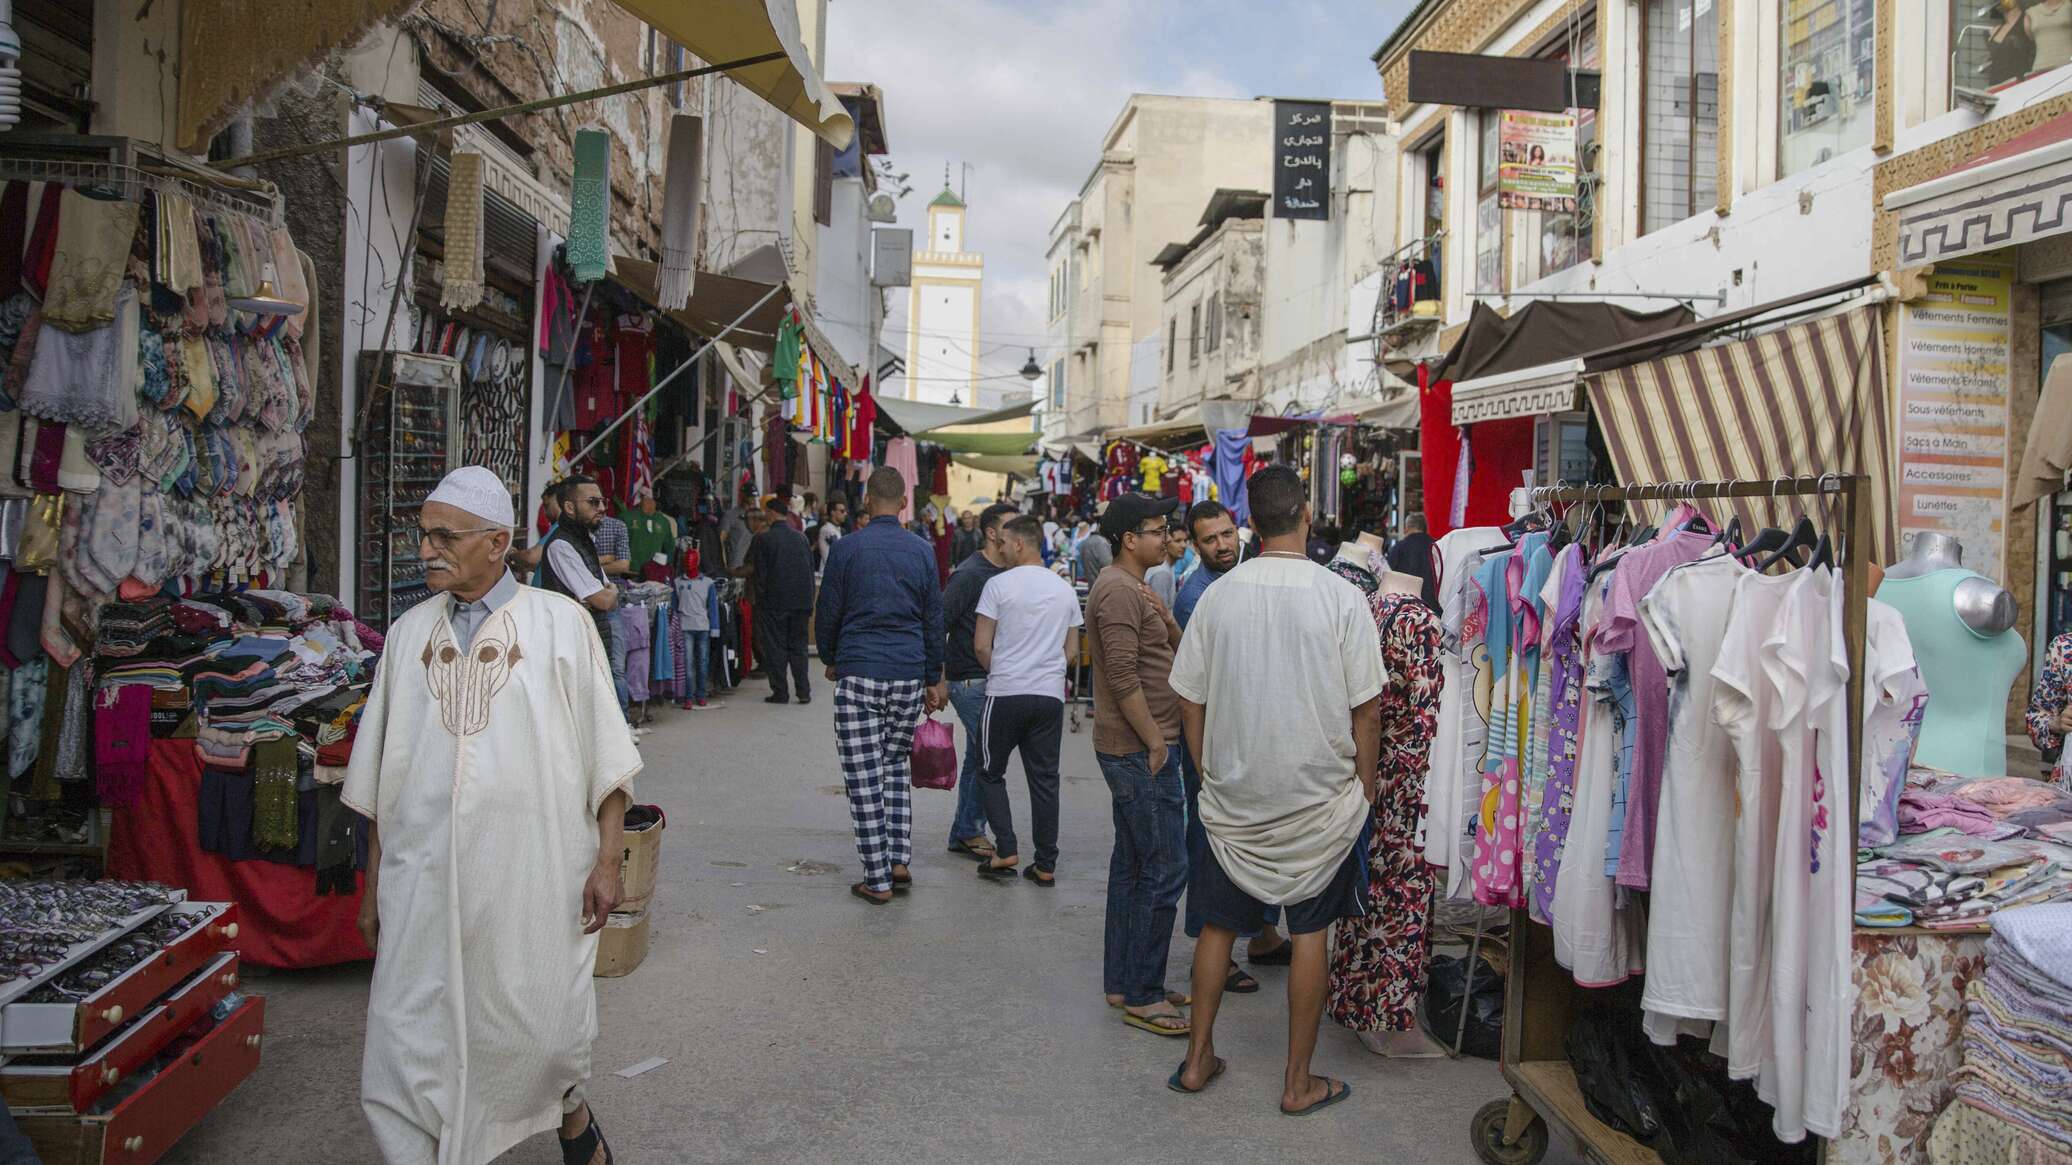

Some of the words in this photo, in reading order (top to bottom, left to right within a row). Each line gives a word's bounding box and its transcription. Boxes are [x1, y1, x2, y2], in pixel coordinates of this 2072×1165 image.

[1956, 282, 1978, 291] Porter
[1912, 308, 1964, 323] Vêtements
[1968, 313, 2008, 326] Femmes
[1911, 341, 1961, 354] Vêtements
[1964, 344, 2006, 356] Hommes
[1910, 372, 1960, 385] Vêtements
[1962, 375, 1997, 389] Enfants
[1908, 403, 1984, 417] Sous-vêtements
[1906, 436, 1930, 447] Sacs
[1942, 438, 1968, 448] Main
[1905, 468, 1971, 481] Accessoires
[1917, 500, 1957, 511] Lunettes
